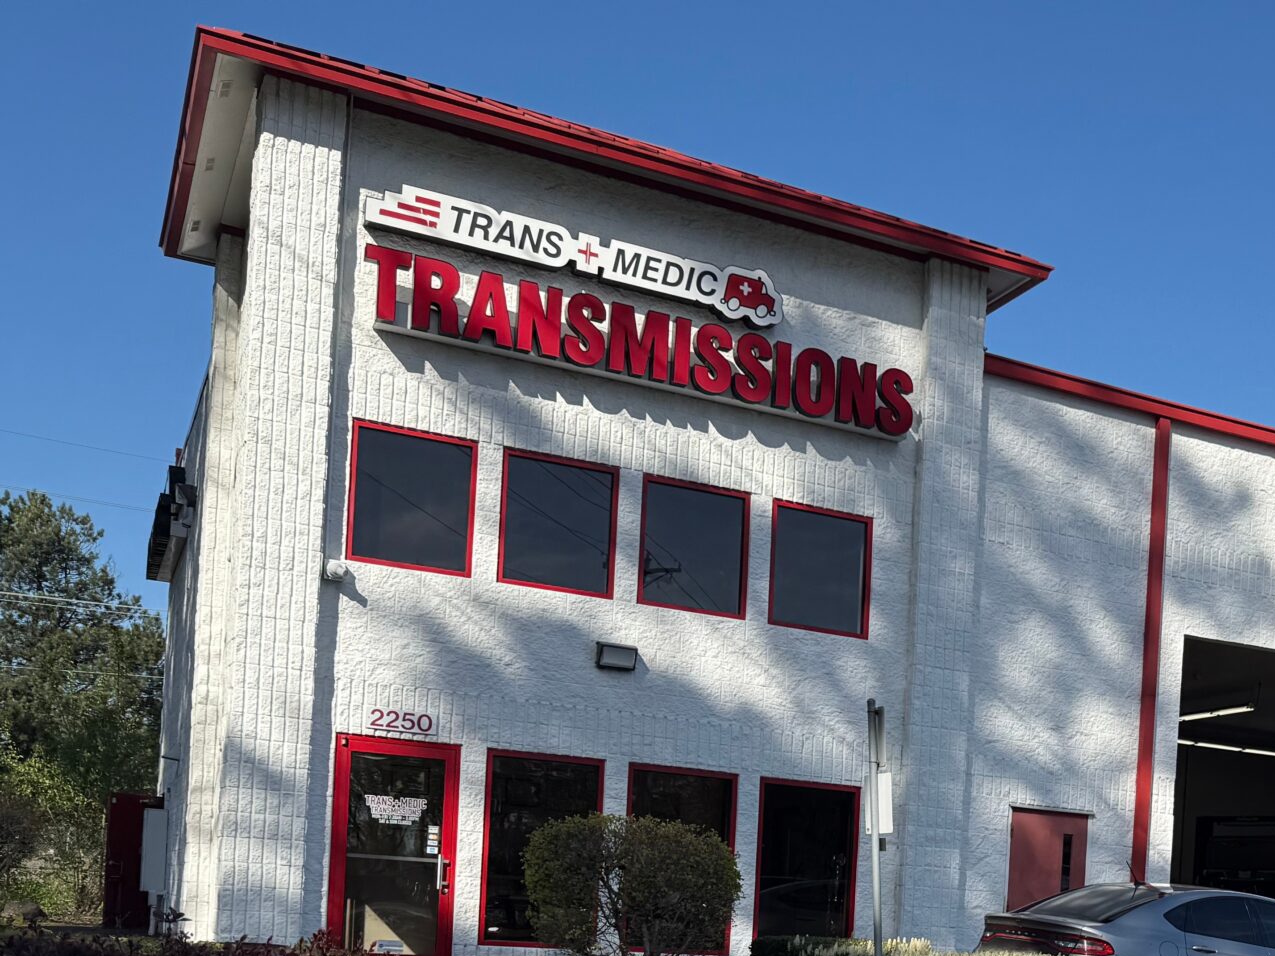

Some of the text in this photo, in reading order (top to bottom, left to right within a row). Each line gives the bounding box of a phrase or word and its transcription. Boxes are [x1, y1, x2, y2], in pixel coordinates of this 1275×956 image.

[450, 205, 718, 297] TRANS MEDIC
[364, 243, 914, 436] TRANSMISSIONS
[370, 708, 433, 732] 2250
[365, 794, 427, 810] TRANS MEDIC
[371, 805, 422, 817] TRANSMISSIONS
